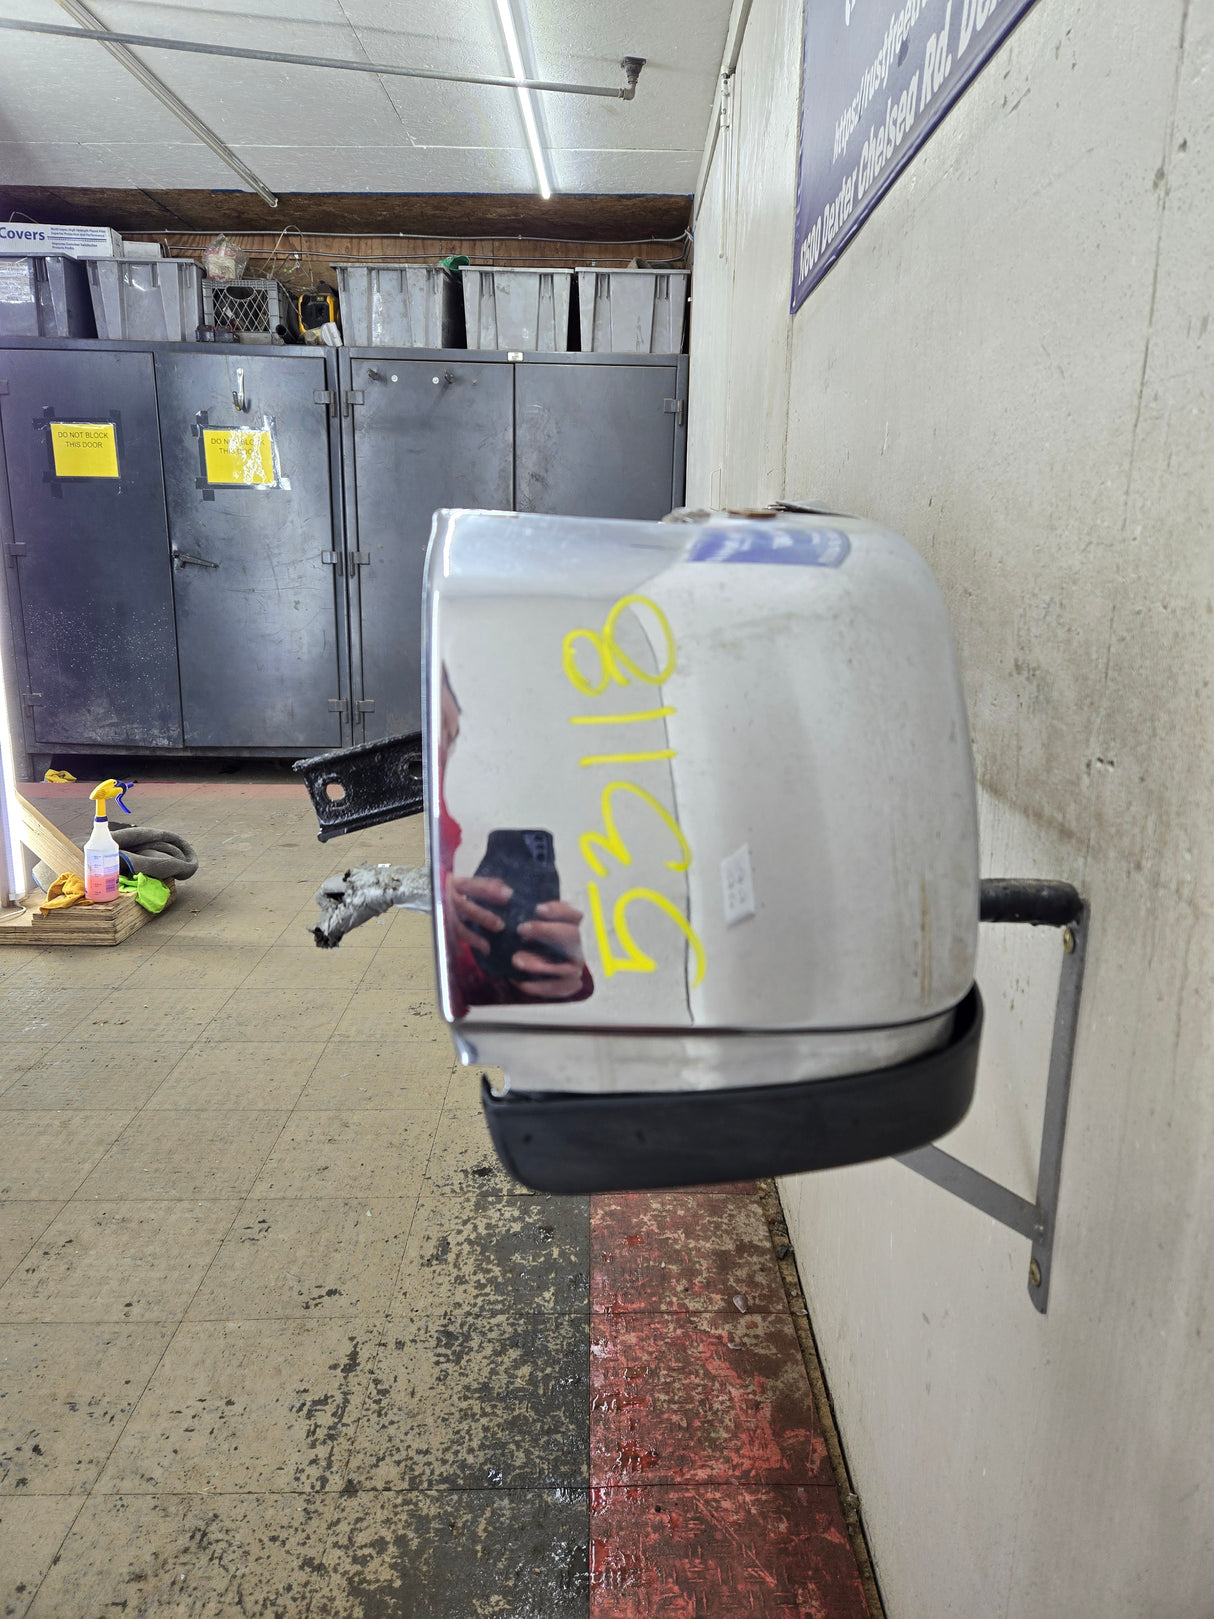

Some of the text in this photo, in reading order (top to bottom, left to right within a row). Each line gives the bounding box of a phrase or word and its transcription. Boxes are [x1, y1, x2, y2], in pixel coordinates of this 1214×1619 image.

[821, 166, 858, 252] Dexter
[858, 69, 919, 200] Chelsea
[920, 0, 952, 112] Rd.
[0, 226, 46, 241] Covers
[69, 431, 83, 439] NOT
[85, 431, 109, 439] BLOCK
[82, 441, 104, 449] DOOR
[562, 594, 706, 988] 53118
